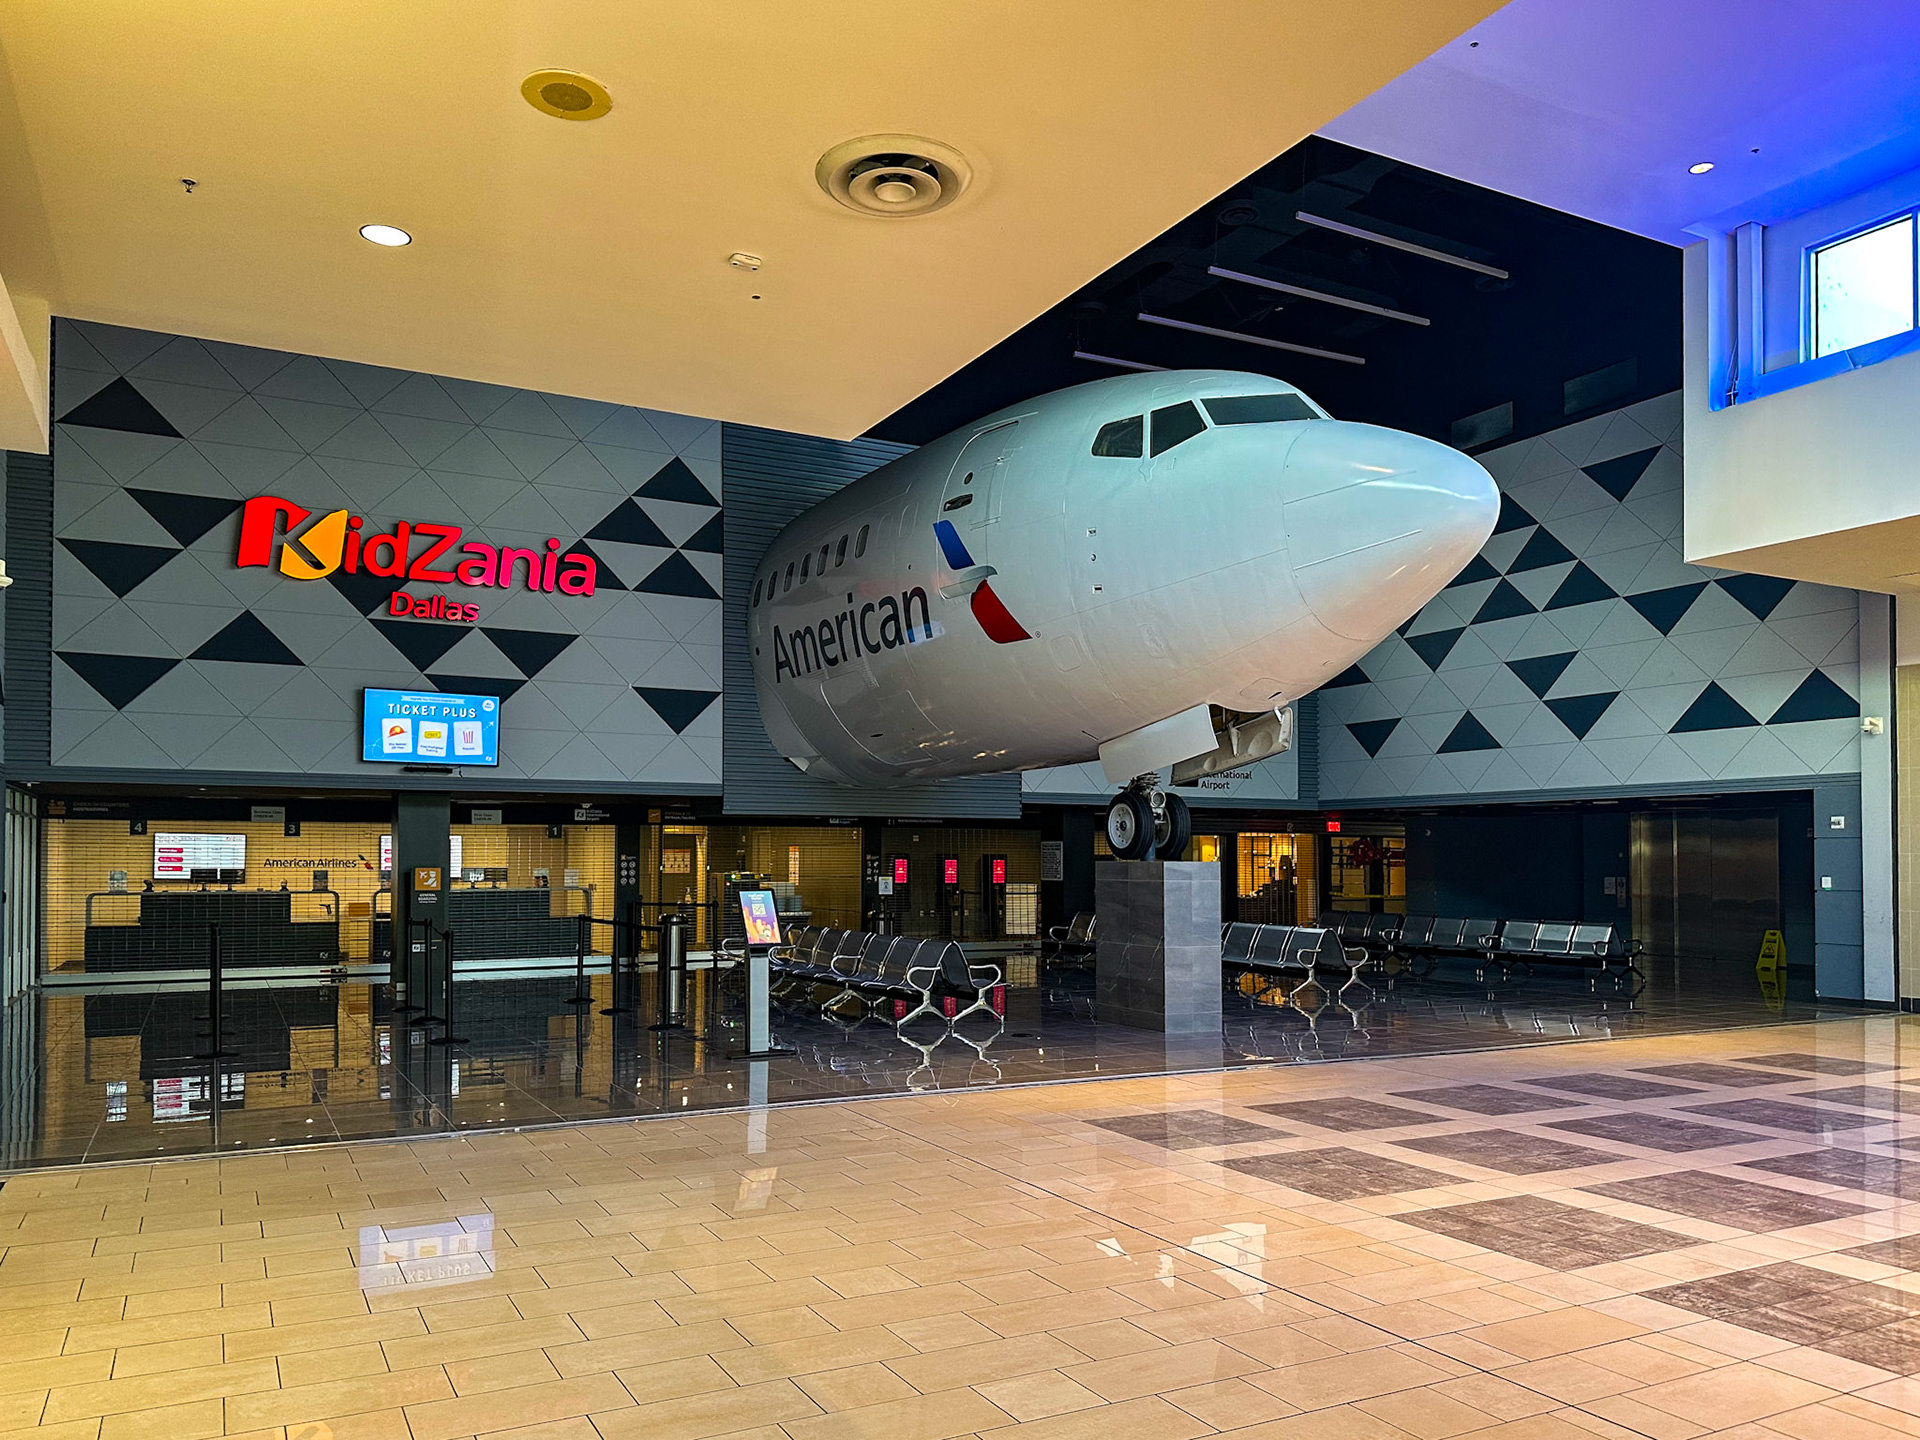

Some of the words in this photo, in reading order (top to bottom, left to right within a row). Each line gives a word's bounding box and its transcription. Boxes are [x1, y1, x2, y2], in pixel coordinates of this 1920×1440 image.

[237, 496, 598, 596] KidZania
[389, 591, 481, 622] Dallas
[773, 586, 934, 684] American
[388, 703, 437, 716] TICKET
[442, 706, 477, 718] PLUS
[1200, 780, 1230, 790] Airport
[134, 823, 142, 832] 4
[288, 824, 296, 834] 3
[552, 826, 558, 836] 1
[263, 858, 316, 868] American
[317, 858, 357, 868] Airlines
